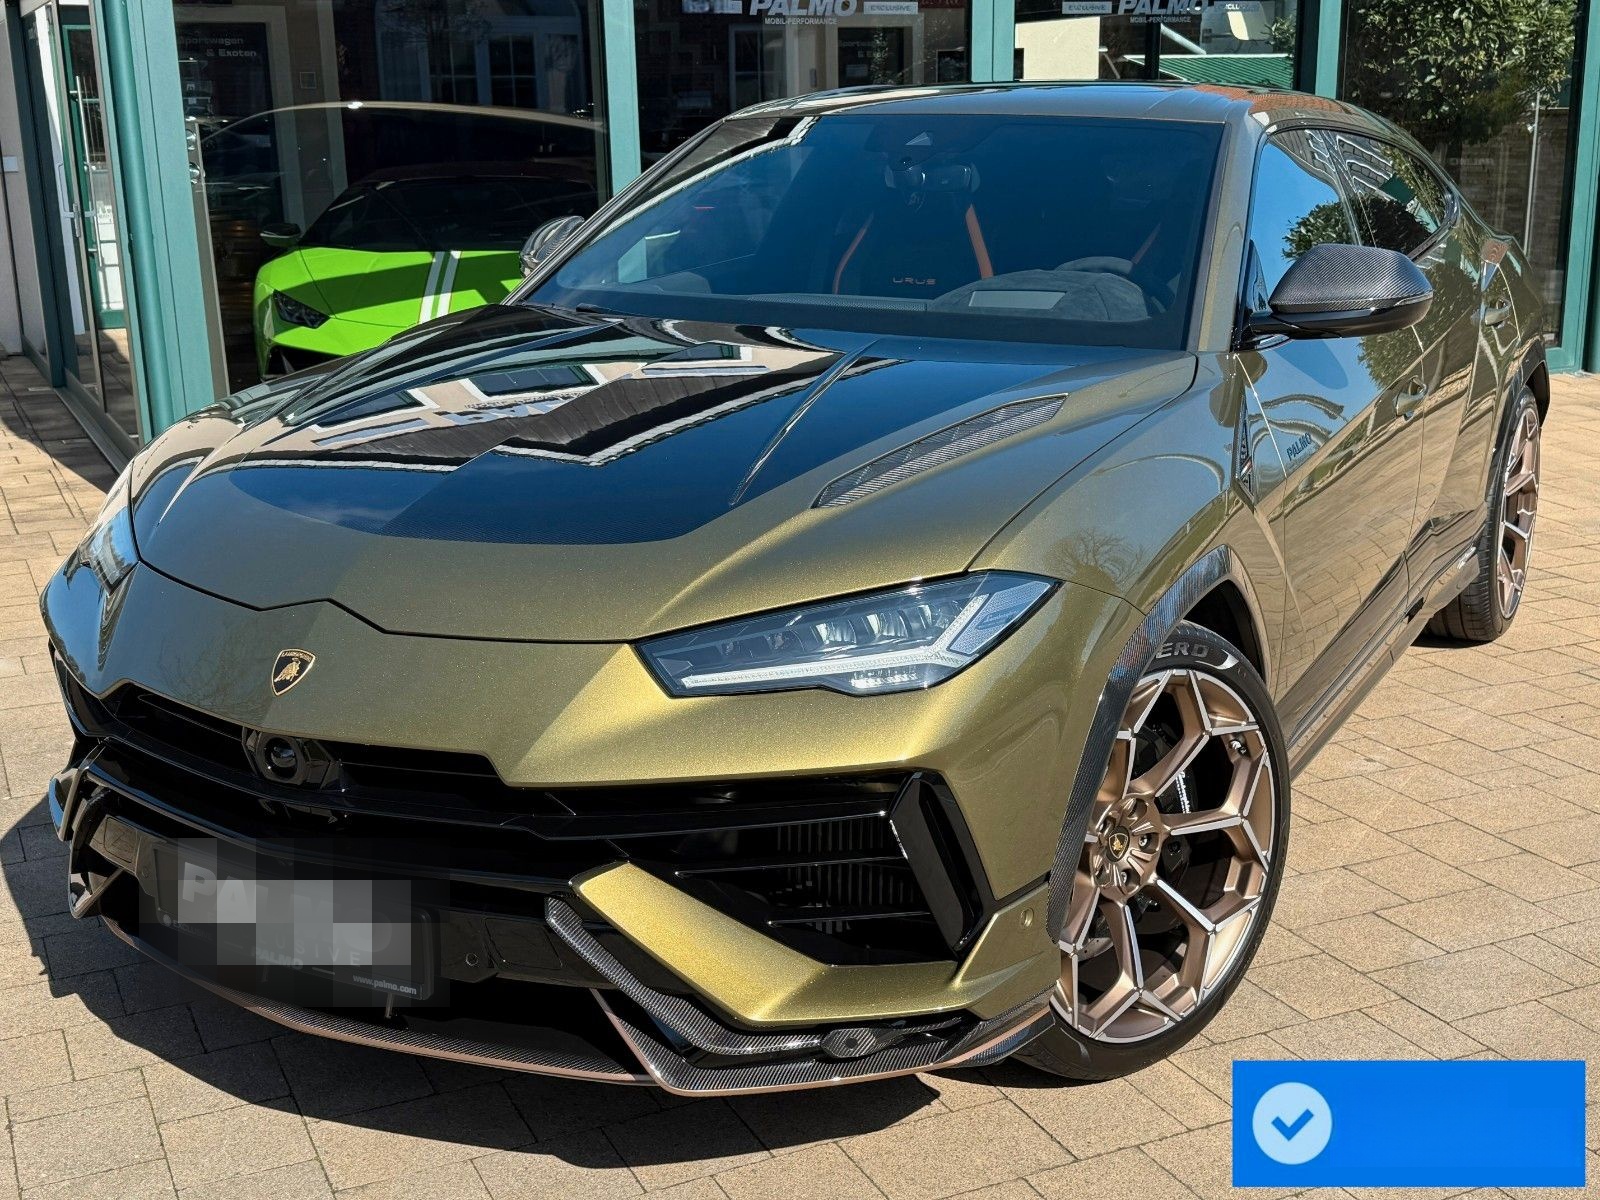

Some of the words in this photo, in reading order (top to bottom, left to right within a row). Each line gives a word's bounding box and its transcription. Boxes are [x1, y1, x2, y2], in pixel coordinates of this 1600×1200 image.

[749, 0, 858, 16] PALMO
[892, 277, 937, 285] URUS
[1156, 641, 1210, 658] ERO
[352, 974, 417, 995] www.palmo.com
